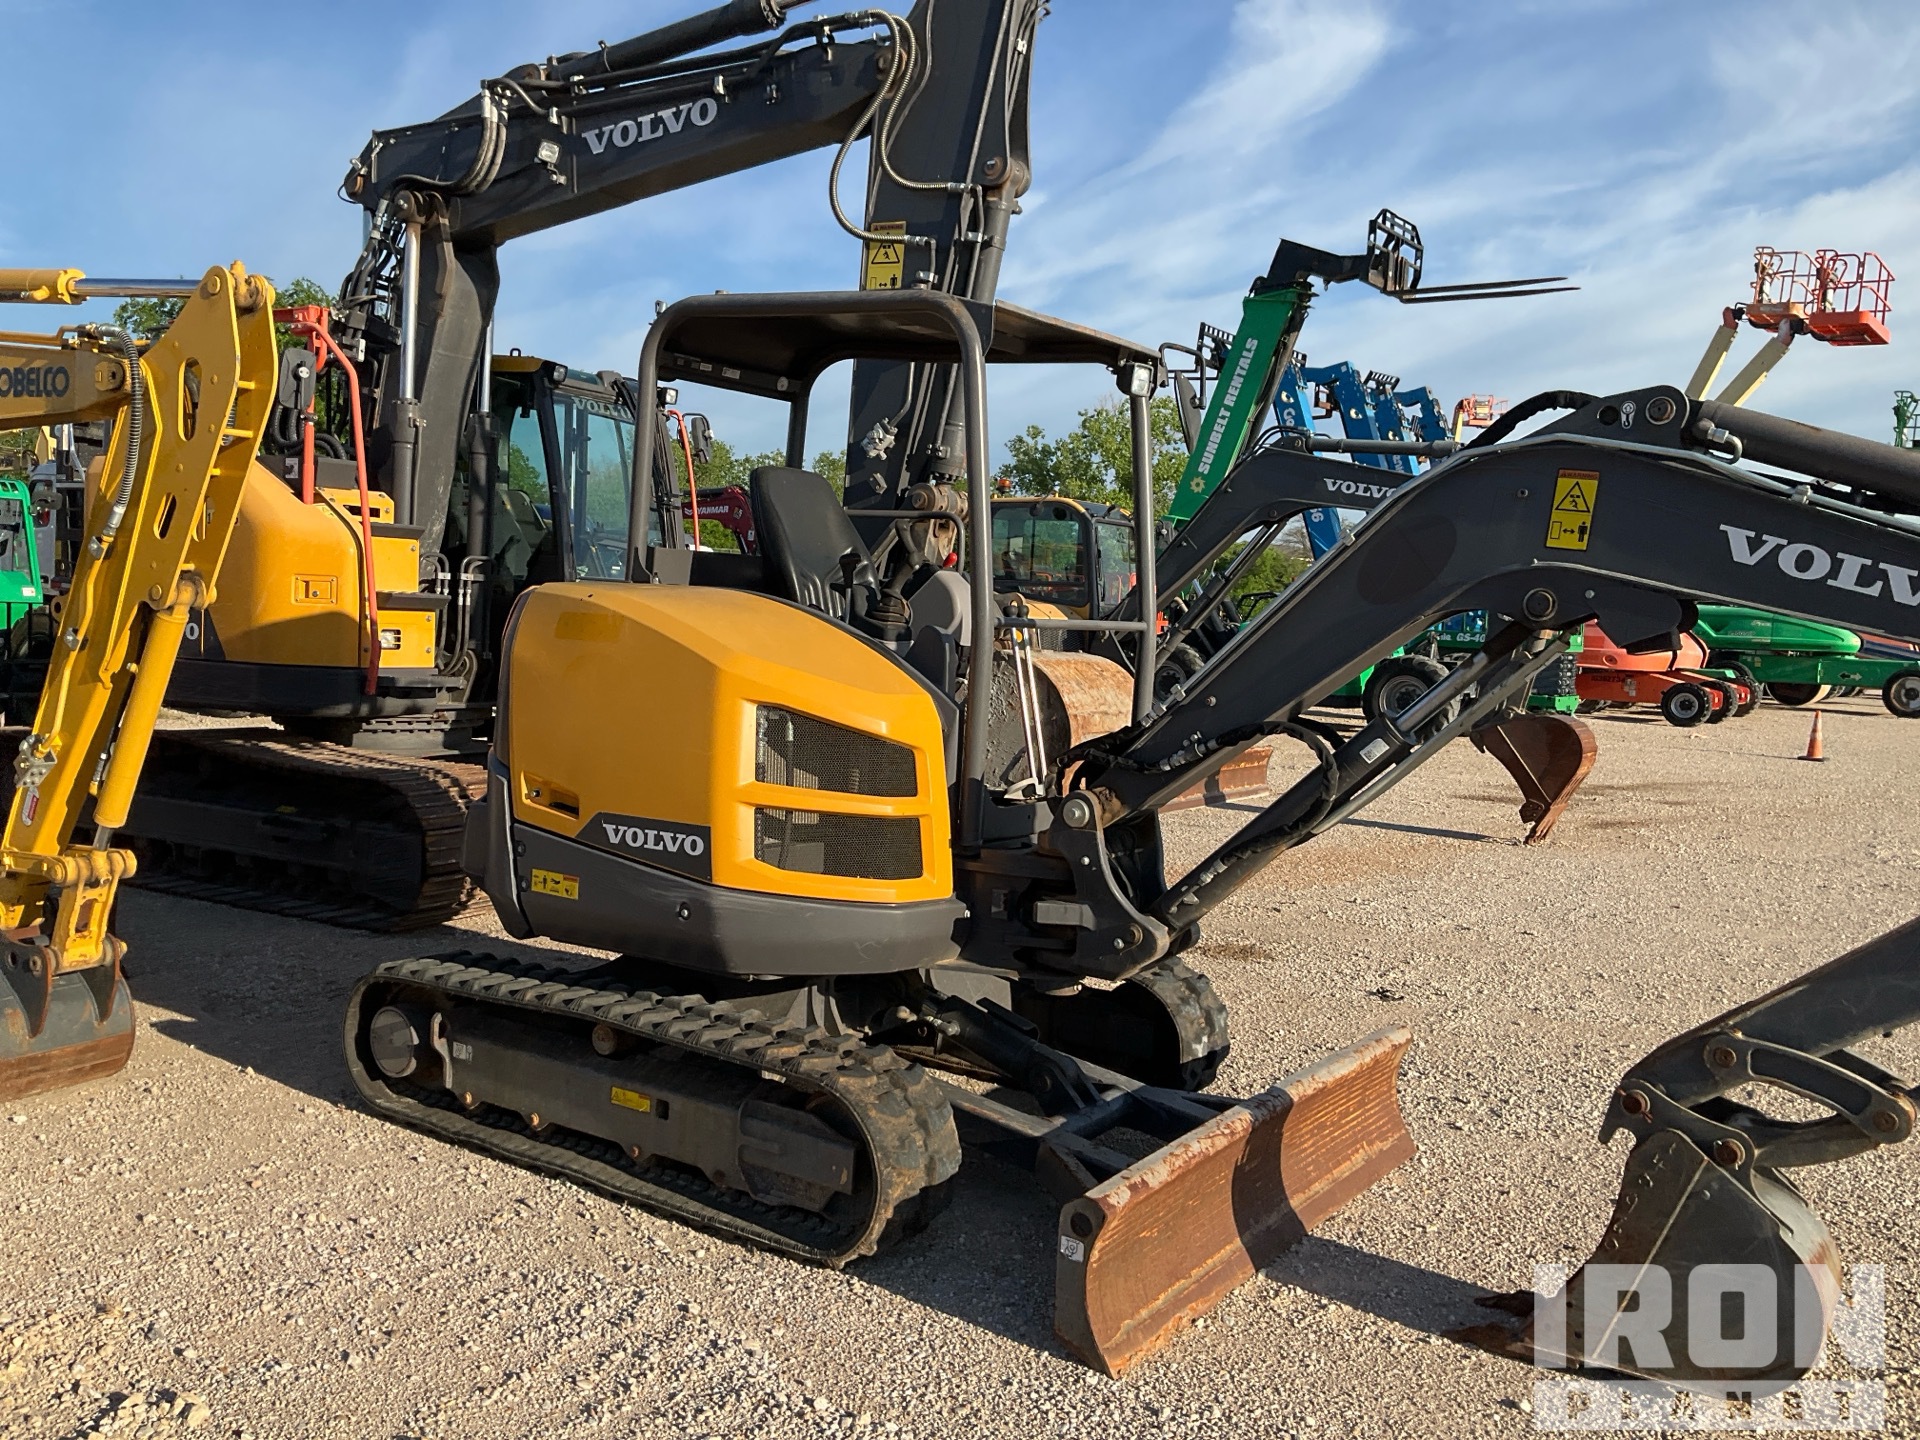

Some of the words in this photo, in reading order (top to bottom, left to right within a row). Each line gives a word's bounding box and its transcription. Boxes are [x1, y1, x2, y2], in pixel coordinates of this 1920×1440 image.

[581, 98, 718, 154] VOLVO
[0, 366, 70, 397] OBELCO
[1198, 407, 1231, 475] SUNBELT
[1223, 337, 1258, 407] RENTALS
[697, 505, 729, 515] YANMAR
[1719, 524, 1920, 607] VOLV
[603, 823, 705, 856] VOLVO
